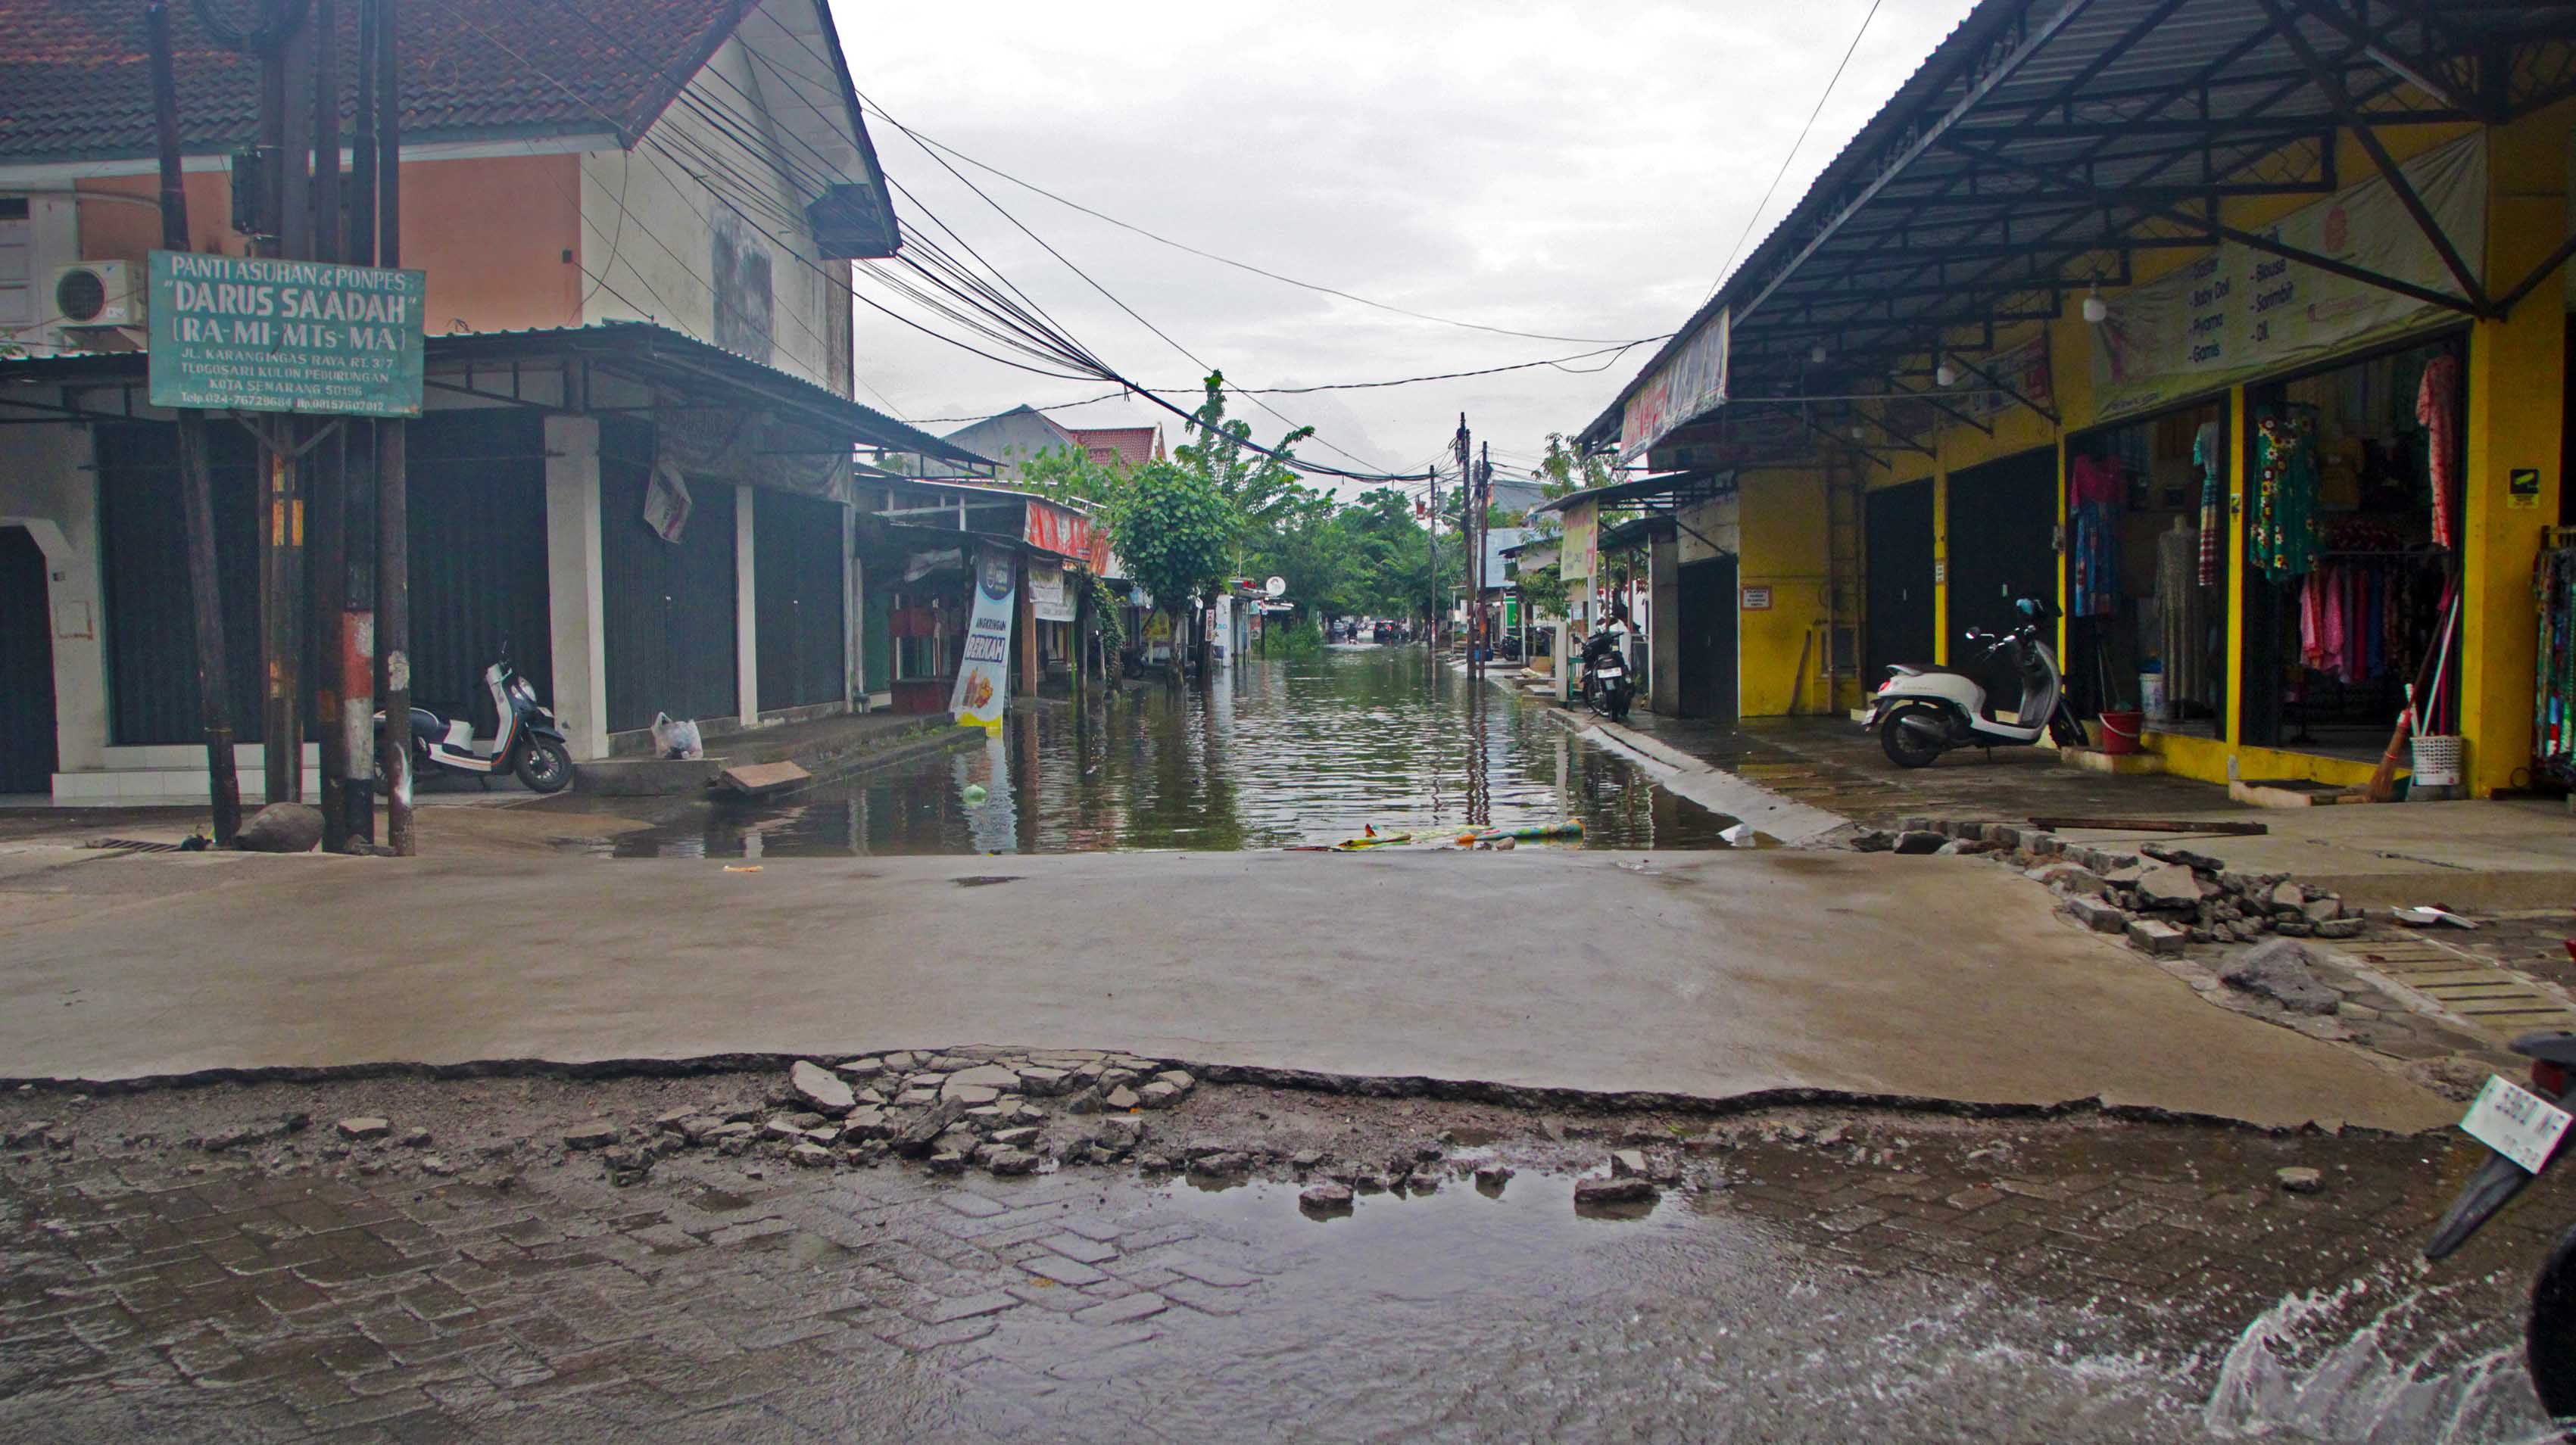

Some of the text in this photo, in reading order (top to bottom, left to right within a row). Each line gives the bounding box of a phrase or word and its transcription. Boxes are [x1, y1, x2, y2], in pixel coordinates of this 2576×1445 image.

[172, 255, 405, 291] PANTI ASUHAN & PONPES
[182, 347, 200, 358] JL.
[206, 348, 306, 364] KARANGINGAS
[311, 354, 345, 367] RAYA
[182, 363, 388, 383] TLOGOSARI KULON PEDURUNGAN
[209, 379, 242, 391] KOTA
[965, 634, 1006, 663] BERKAH
